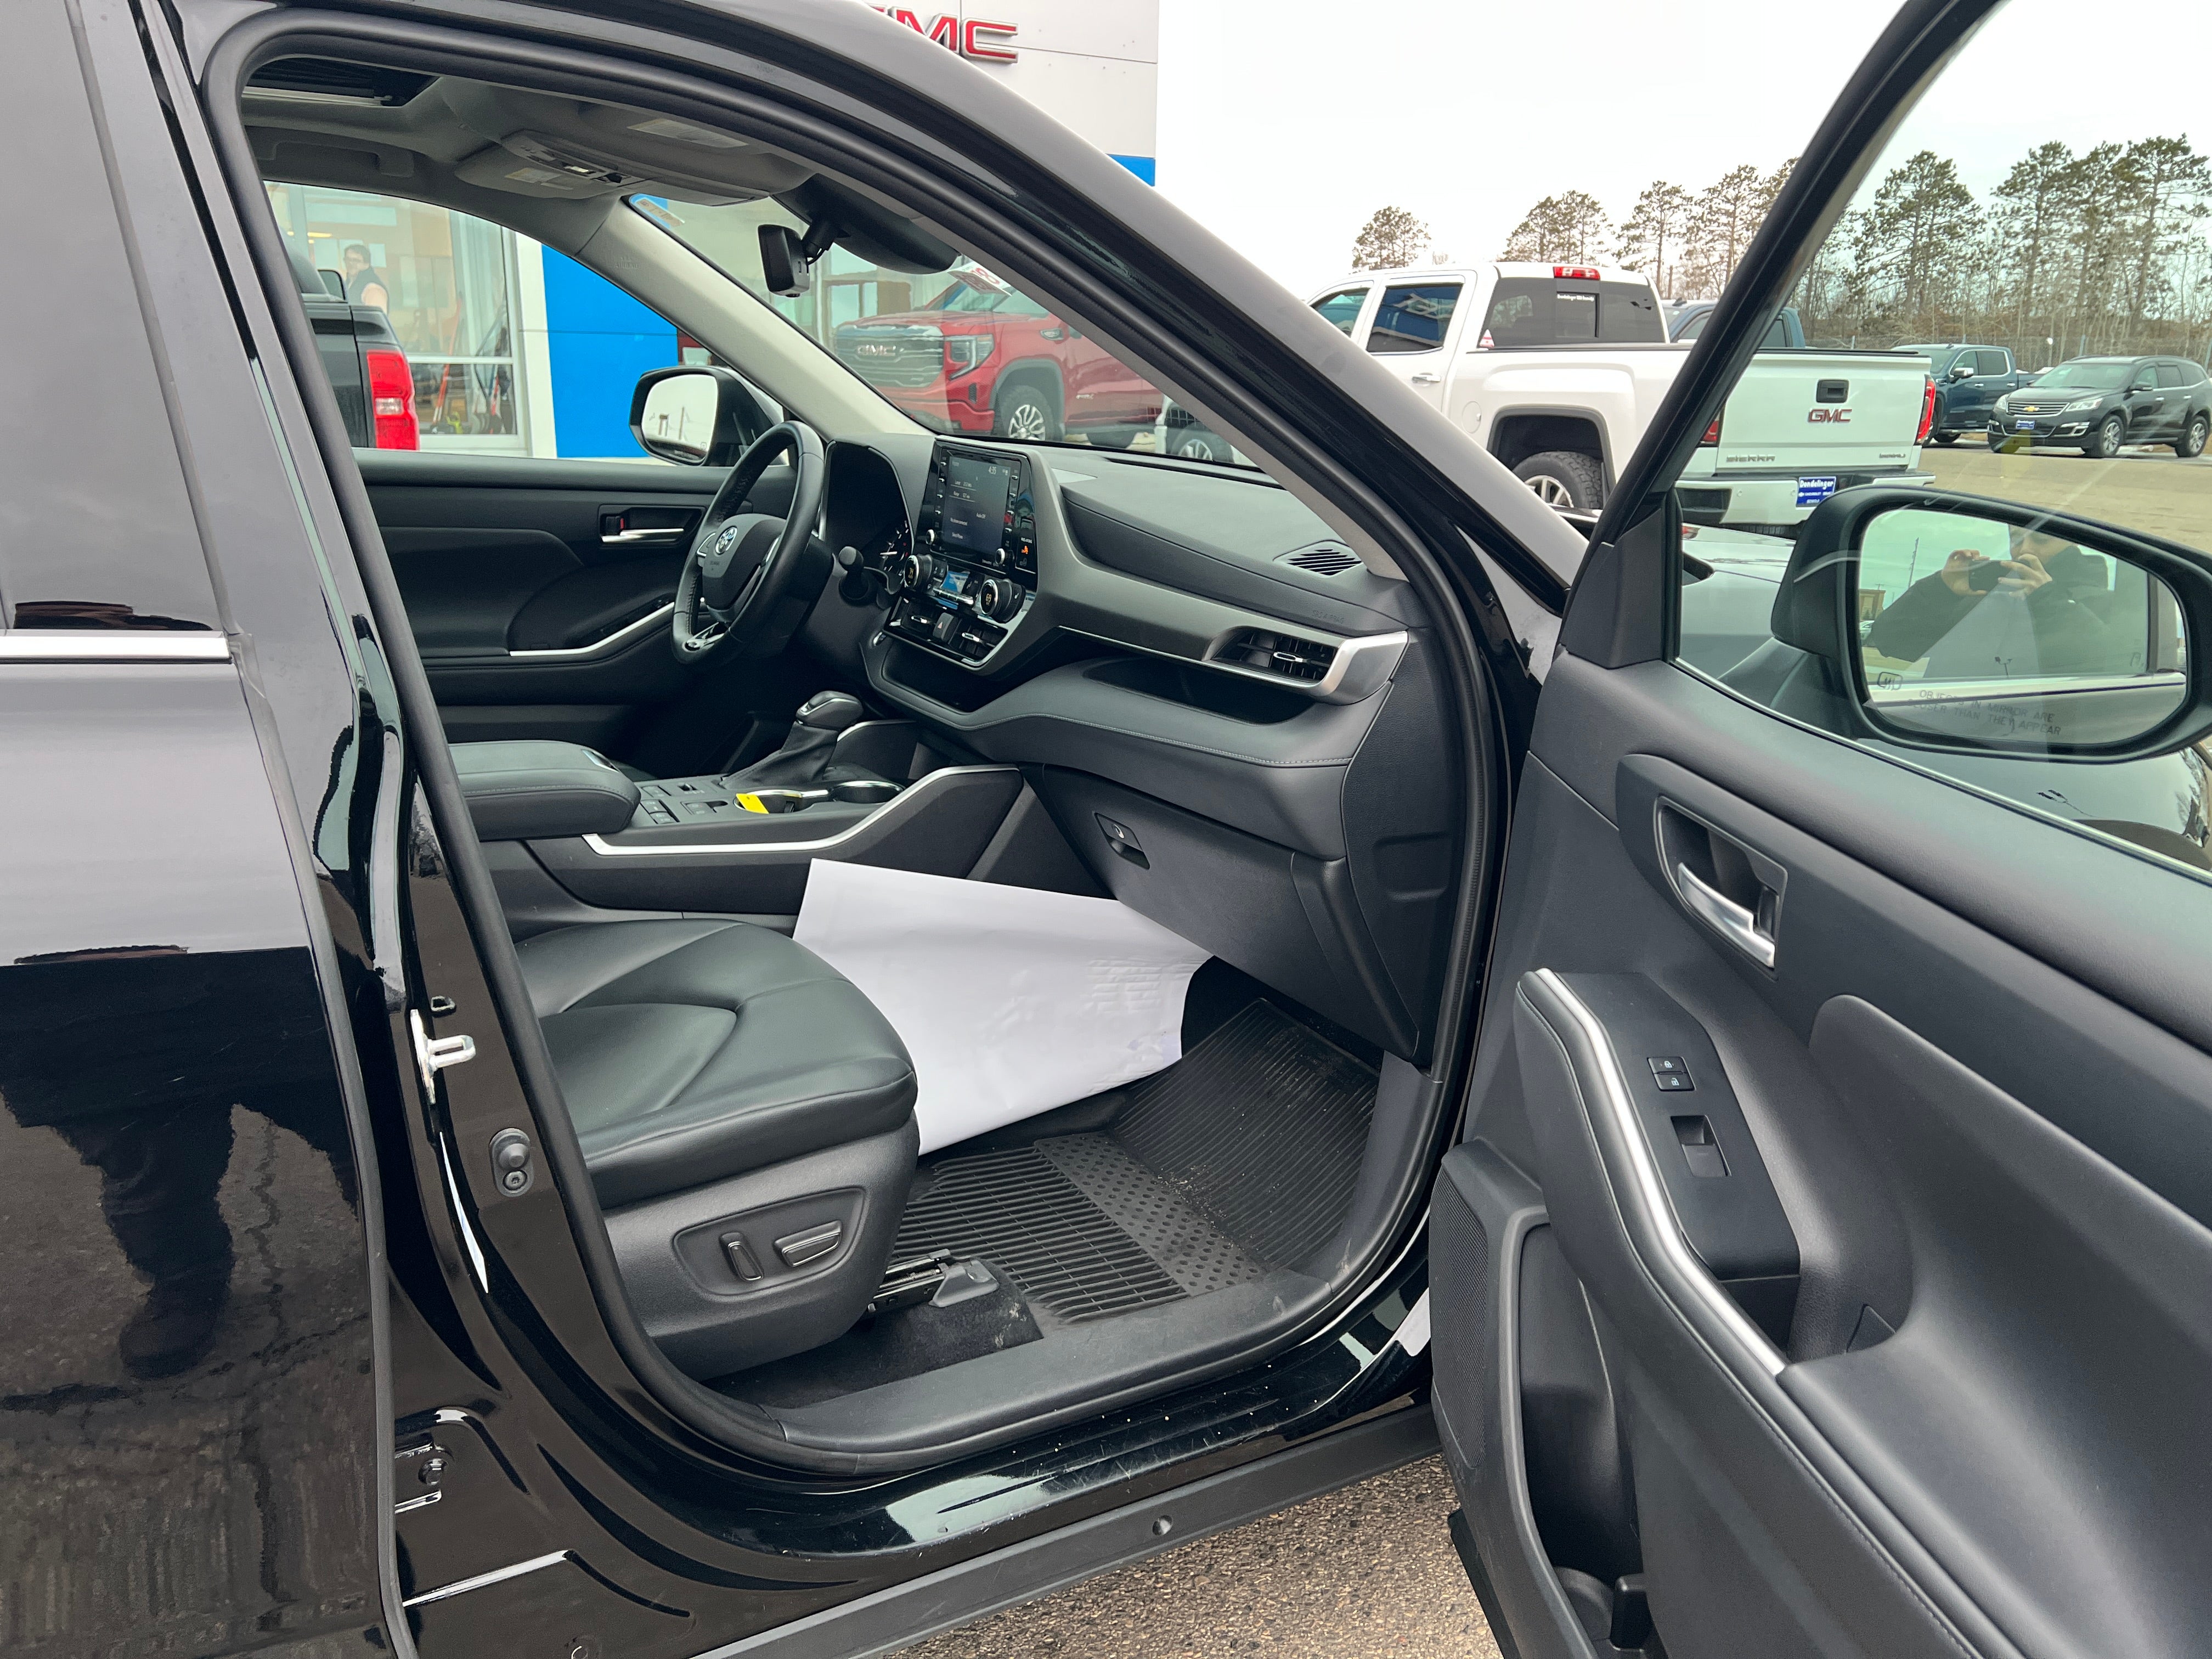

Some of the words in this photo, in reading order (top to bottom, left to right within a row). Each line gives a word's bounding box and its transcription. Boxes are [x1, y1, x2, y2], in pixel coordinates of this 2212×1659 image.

[868, 4, 1019, 63] MC
[857, 345, 896, 356] GMC
[1808, 408, 1853, 422] GMC
[1799, 479, 1834, 490] Dondelinger
[1971, 700, 1982, 709] IN
[1987, 702, 2028, 716] MIRROR
[2033, 712, 2055, 723] ARE
[1954, 707, 1982, 720] THAN
[2017, 720, 2062, 736] APPEAR
